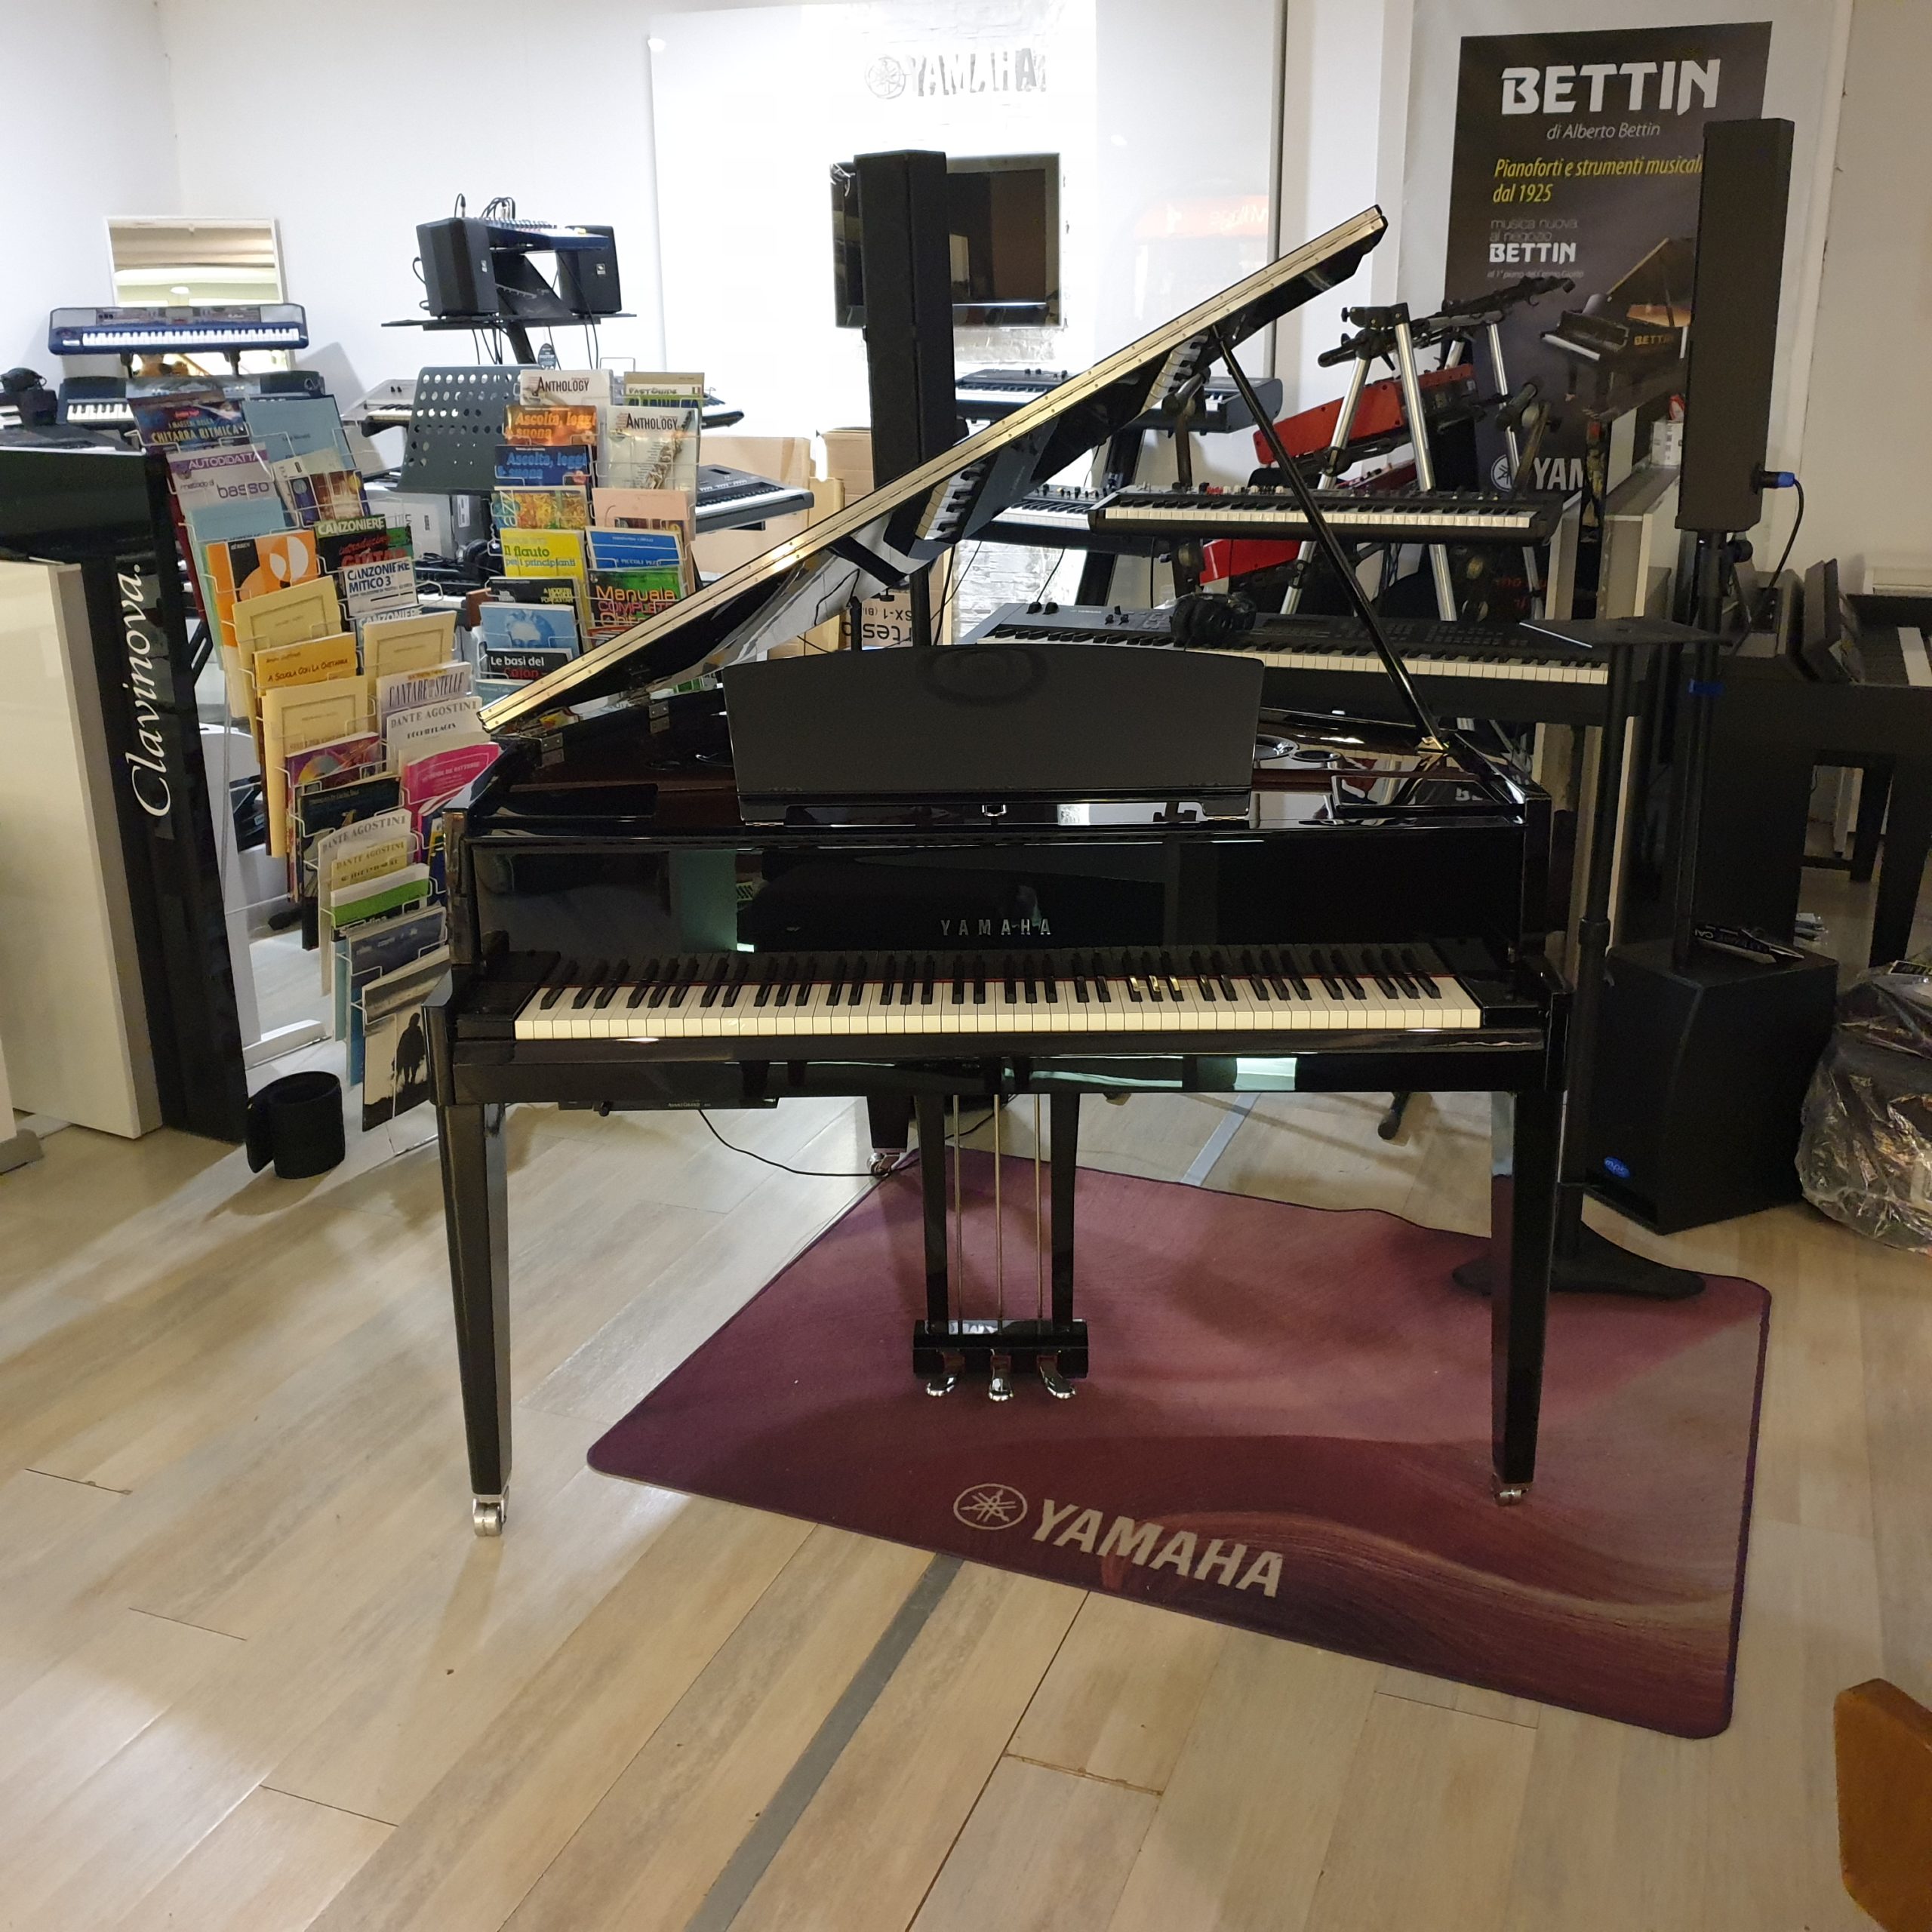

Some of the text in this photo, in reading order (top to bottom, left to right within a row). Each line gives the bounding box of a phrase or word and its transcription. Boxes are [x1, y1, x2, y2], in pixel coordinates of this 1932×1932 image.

[906, 48, 1046, 97] YAMAHA
[1501, 59, 1720, 115] BETTIN
[1547, 122, 1660, 140] di Alberto Bettin
[1494, 156, 1564, 178] Pianoforti
[1564, 162, 1572, 177] e
[1576, 155, 1644, 177] strumenti
[1493, 183, 1553, 203] dal 1925
[1491, 218, 1578, 229] musica nuova
[1489, 242, 1577, 264] BETTIN
[151, 424, 239, 444] CHITARRA RITMICA
[189, 453, 262, 469] AUTODIDATTA
[216, 481, 269, 499] basso
[318, 518, 385, 535] CANZONIERE
[514, 545, 549, 557] flauto
[347, 561, 411, 580] CANZONIERE
[525, 558, 576, 568] principianti
[349, 577, 384, 594] MITICO
[385, 576, 392, 586] 3
[491, 655, 544, 666] Le basi del
[389, 678, 427, 707] CANTARE
[435, 672, 465, 696] STELLE
[390, 700, 477, 728] DANTE AGOSTINI
[322, 815, 407, 853] DANTE AGOSTINI
[337, 841, 405, 869] DANTE AGOSTINI
[940, 918, 1051, 936] YAMAHA
[1032, 1498, 1284, 1598] YAMAHA
